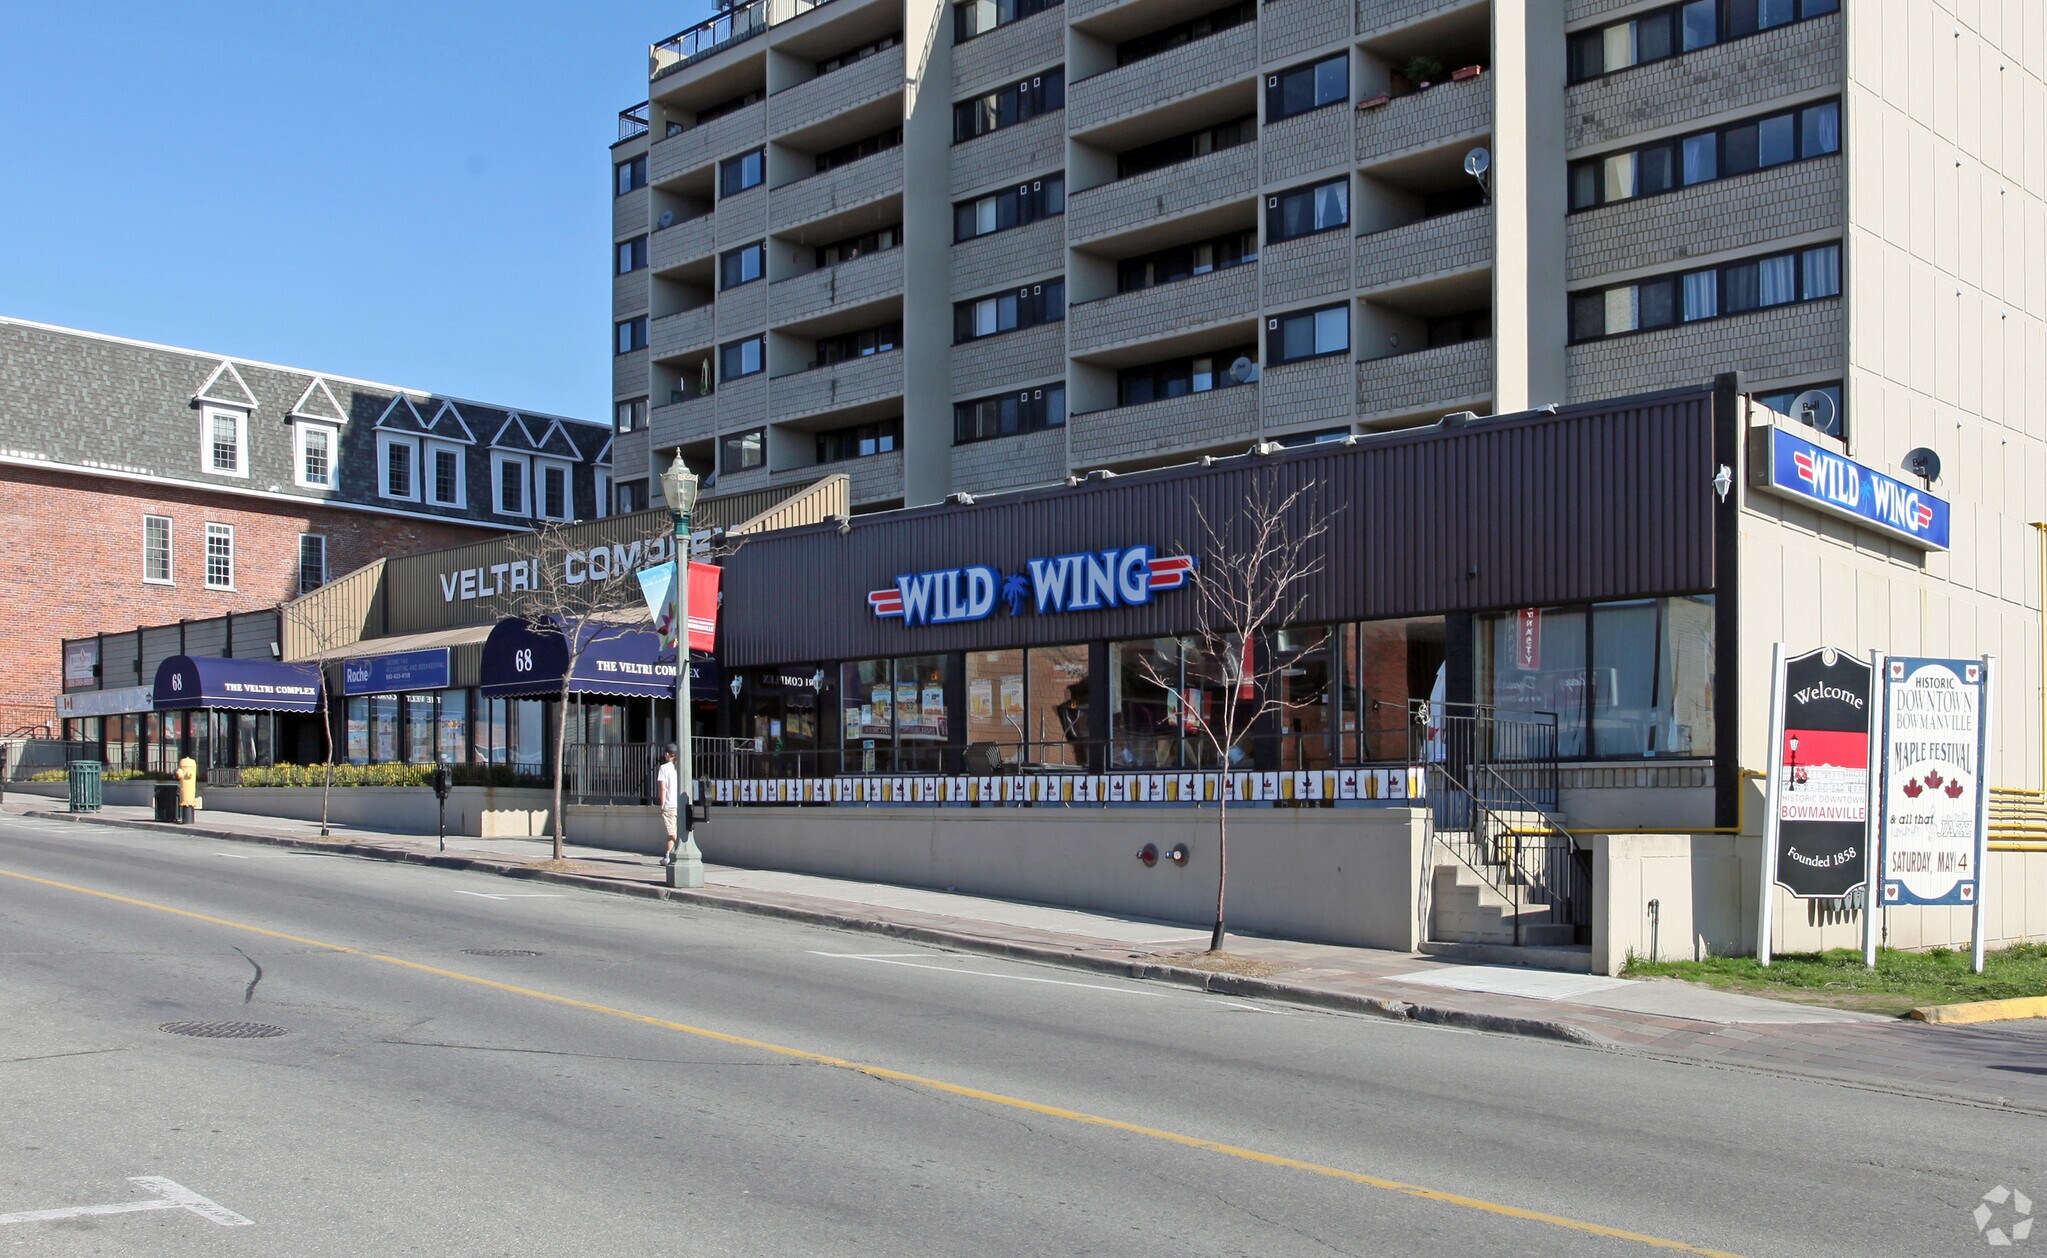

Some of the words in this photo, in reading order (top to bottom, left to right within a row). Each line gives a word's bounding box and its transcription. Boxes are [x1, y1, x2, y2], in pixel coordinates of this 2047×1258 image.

[1802, 400, 1820, 411] Bell
[1912, 456, 1928, 467] Bell
[1809, 448, 1860, 507] WILD
[1871, 475, 1921, 532] WING
[440, 559, 538, 602] VELTRI
[898, 566, 994, 624] WILD
[1029, 547, 1150, 614] WING
[515, 648, 532, 672] 68
[597, 660, 617, 672] THE
[619, 662, 652, 675] VELTRI
[172, 673, 183, 691] 68
[224, 683, 243, 692] THE
[244, 684, 274, 693] VELTRI
[276, 686, 315, 695] COMPLEX
[1915, 677, 1956, 689] HISTORIC
[1793, 681, 1864, 710] Welcome
[1897, 689, 1972, 713] DOWNTOWN
[1896, 713, 1972, 731] BOWMANVILLE
[1894, 742, 1926, 775] MAPLE
[1929, 742, 1972, 775] FESTIVAL
[1783, 794, 1817, 803] HISTORIC
[1819, 795, 1865, 804] DOWNTOWN
[1781, 805, 1865, 819] BOWMANVILLE
[1890, 815, 1897, 824] &
[1899, 814, 1912, 825] all
[1914, 814, 1934, 825] that
[1937, 820, 1973, 837] JAZZ
[1787, 846, 1831, 868] Founded
[1833, 847, 1857, 866] 1858
[1937, 852, 1955, 873] MAY
[1958, 853, 1968, 871] 4
